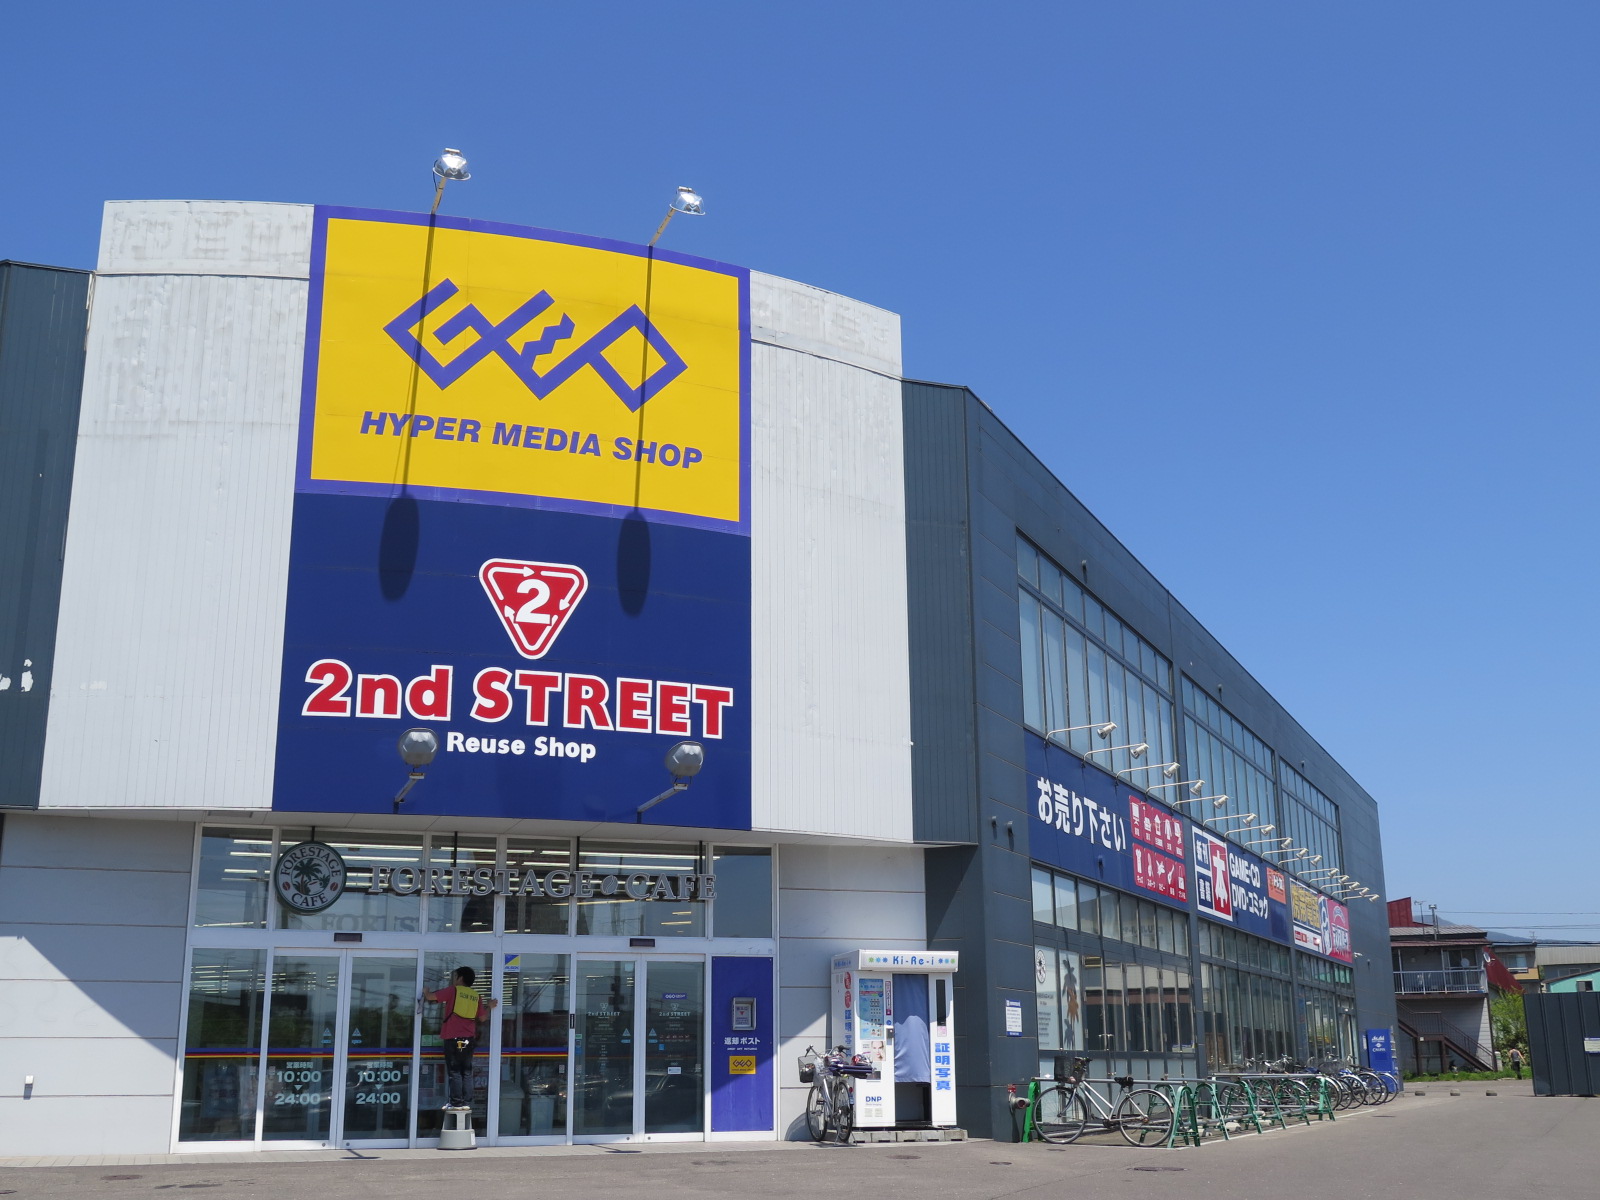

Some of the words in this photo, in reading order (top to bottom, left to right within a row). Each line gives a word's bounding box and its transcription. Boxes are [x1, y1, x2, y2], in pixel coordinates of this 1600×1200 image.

[359, 410, 481, 443] HYPER
[492, 422, 602, 457] MEDIA
[612, 436, 704, 470] SHOP
[516, 579, 551, 625] 2
[301, 658, 454, 722] 2nd
[470, 667, 734, 740] STREET
[446, 731, 526, 757] Reuse
[534, 736, 597, 763] Shop
[1037, 776, 1126, 851] お売り下さい
[280, 846, 341, 877] FORESTAGE
[367, 864, 594, 898] FORESTAGE
[625, 872, 718, 900] CAFE
[1212, 850, 1228, 908] 本
[291, 893, 328, 907] CAFE
[892, 956, 934, 965] Ki-Re-i
[276, 1070, 321, 1082] 10:00
[358, 1070, 401, 1082] 10:00
[935, 1043, 950, 1090] 証明写真
[274, 1092, 320, 1105] 24:00
[356, 1092, 400, 1104] 24:00
